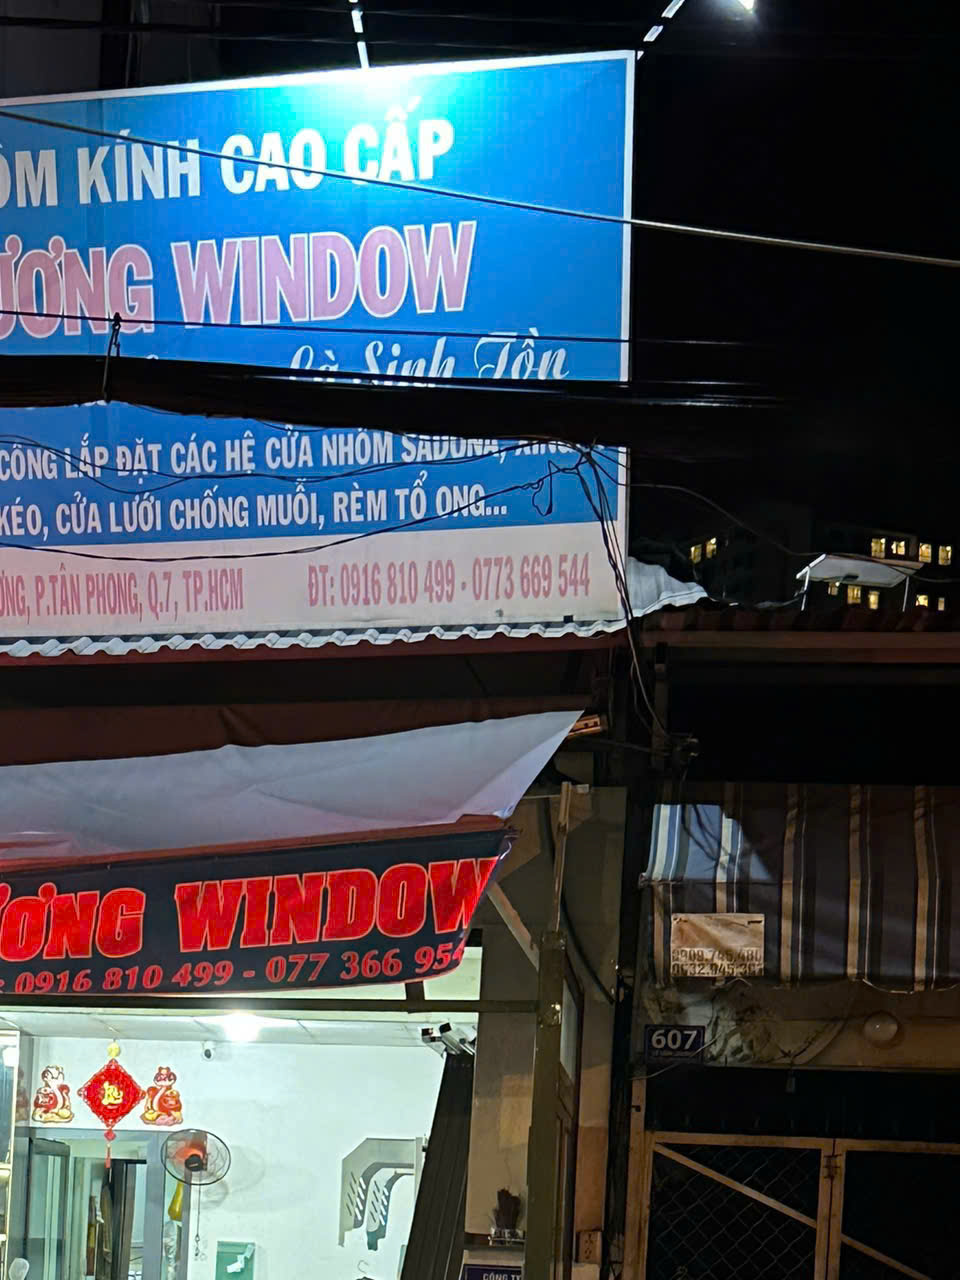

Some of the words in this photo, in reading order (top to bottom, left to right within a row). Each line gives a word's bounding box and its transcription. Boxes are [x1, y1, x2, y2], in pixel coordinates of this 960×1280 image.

[78, 129, 201, 204] KÍNH
[220, 129, 327, 194] CAO
[343, 96, 454, 186] CẤP
[170, 220, 477, 329] WINDOW
[65, 432, 110, 480] LẮP
[115, 438, 162, 484] ĐẶT
[170, 433, 217, 475] CÁC
[225, 430, 256, 475] HỆ
[265, 424, 315, 470] CỬA
[322, 428, 393, 465] NHÔM
[55, 491, 102, 534] CỬA
[110, 492, 162, 533] LƯỚI
[170, 485, 249, 530] CHỐNG
[257, 478, 325, 531] MUỖI,
[333, 482, 388, 523] RÈM
[395, 470, 429, 520] TỔ
[86, 571, 142, 622] PHONG,
[308, 564, 335, 608] ĐT:
[340, 562, 381, 606] 0916
[387, 560, 418, 605] 810
[423, 559, 456, 603] 499
[472, 556, 514, 602] 0773
[520, 554, 552, 599] 669
[558, 552, 591, 598] 544
[174, 855, 499, 952] WINDOW
[15, 969, 92, 993] 0916
[102, 964, 164, 991] 810
[172, 960, 234, 988] 499
[265, 952, 330, 984] 077
[340, 949, 403, 980] 366
[651, 1029, 698, 1050] 607
